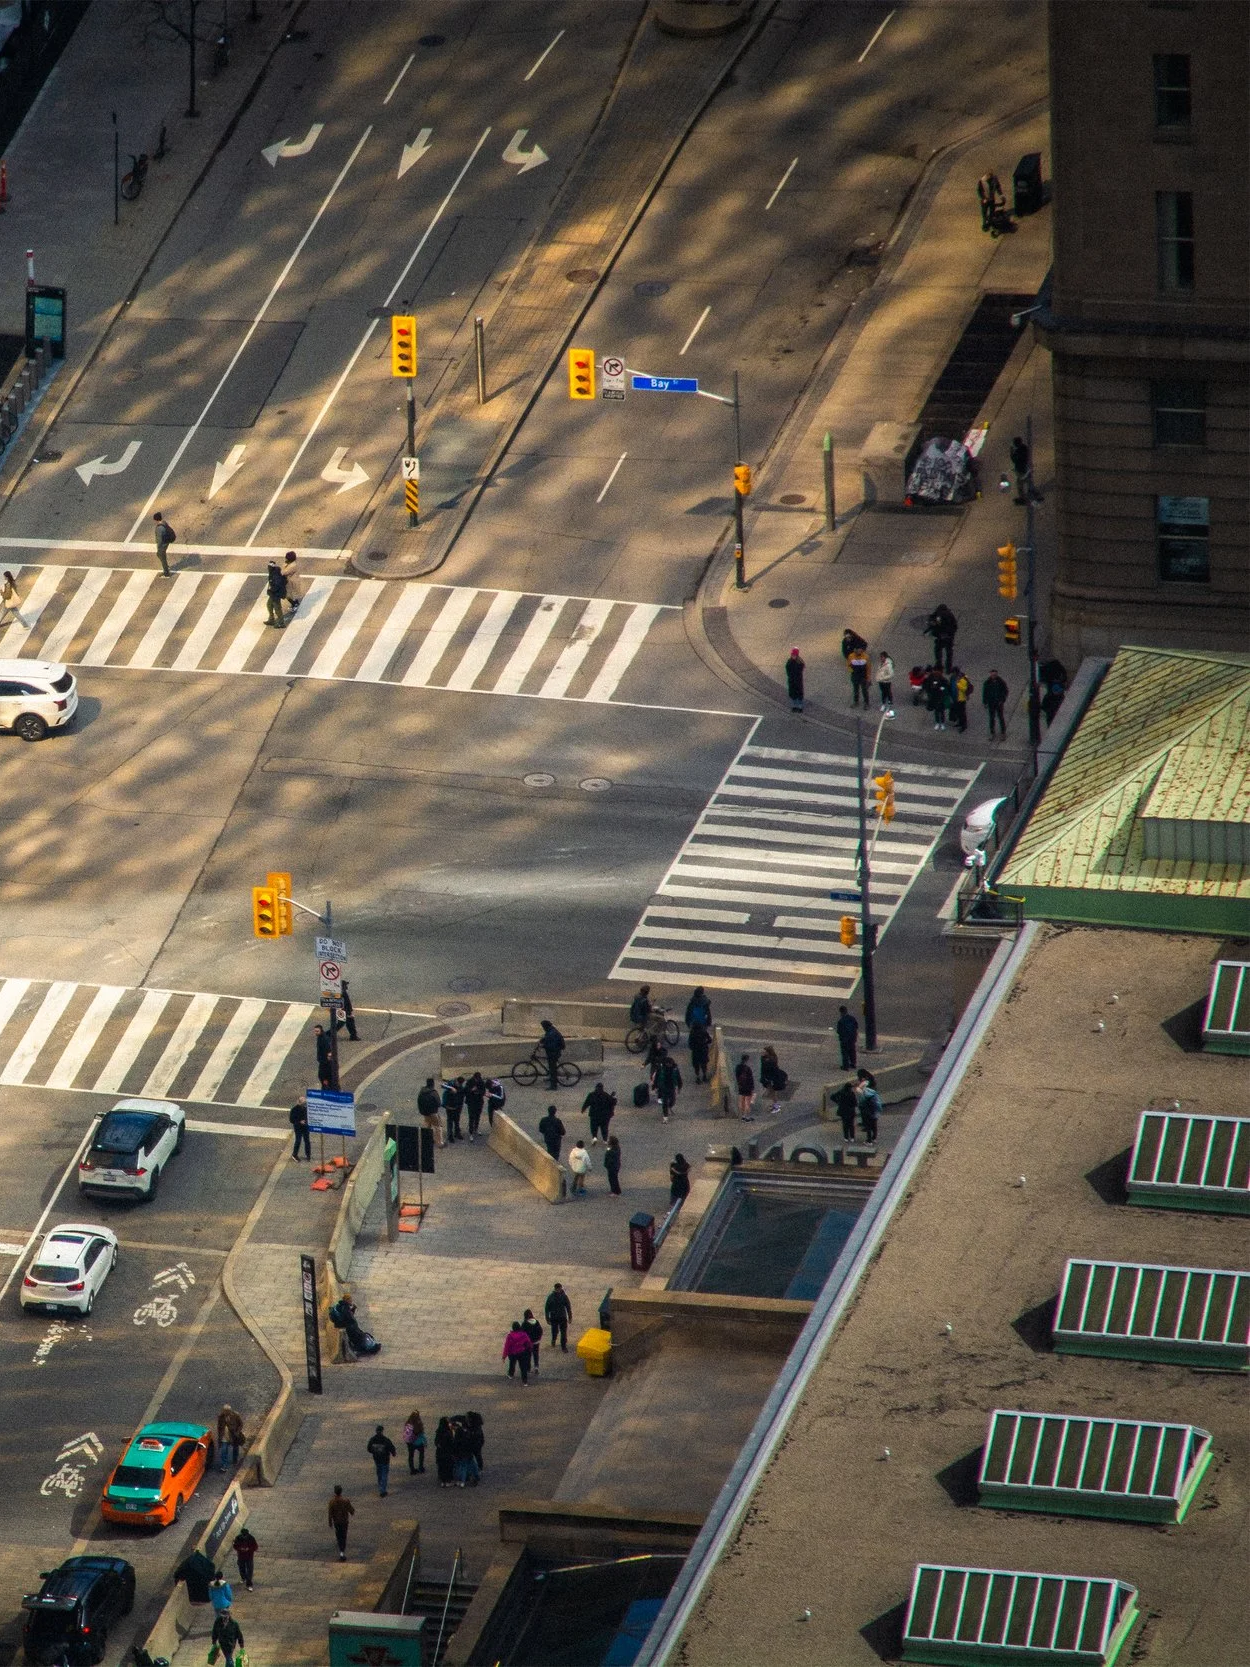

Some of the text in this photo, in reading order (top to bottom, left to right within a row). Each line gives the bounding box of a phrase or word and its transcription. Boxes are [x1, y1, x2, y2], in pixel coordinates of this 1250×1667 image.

[650, 378, 670, 391] Bay
[331, 939, 343, 948] NOT
[321, 944, 342, 954] BLOCK
